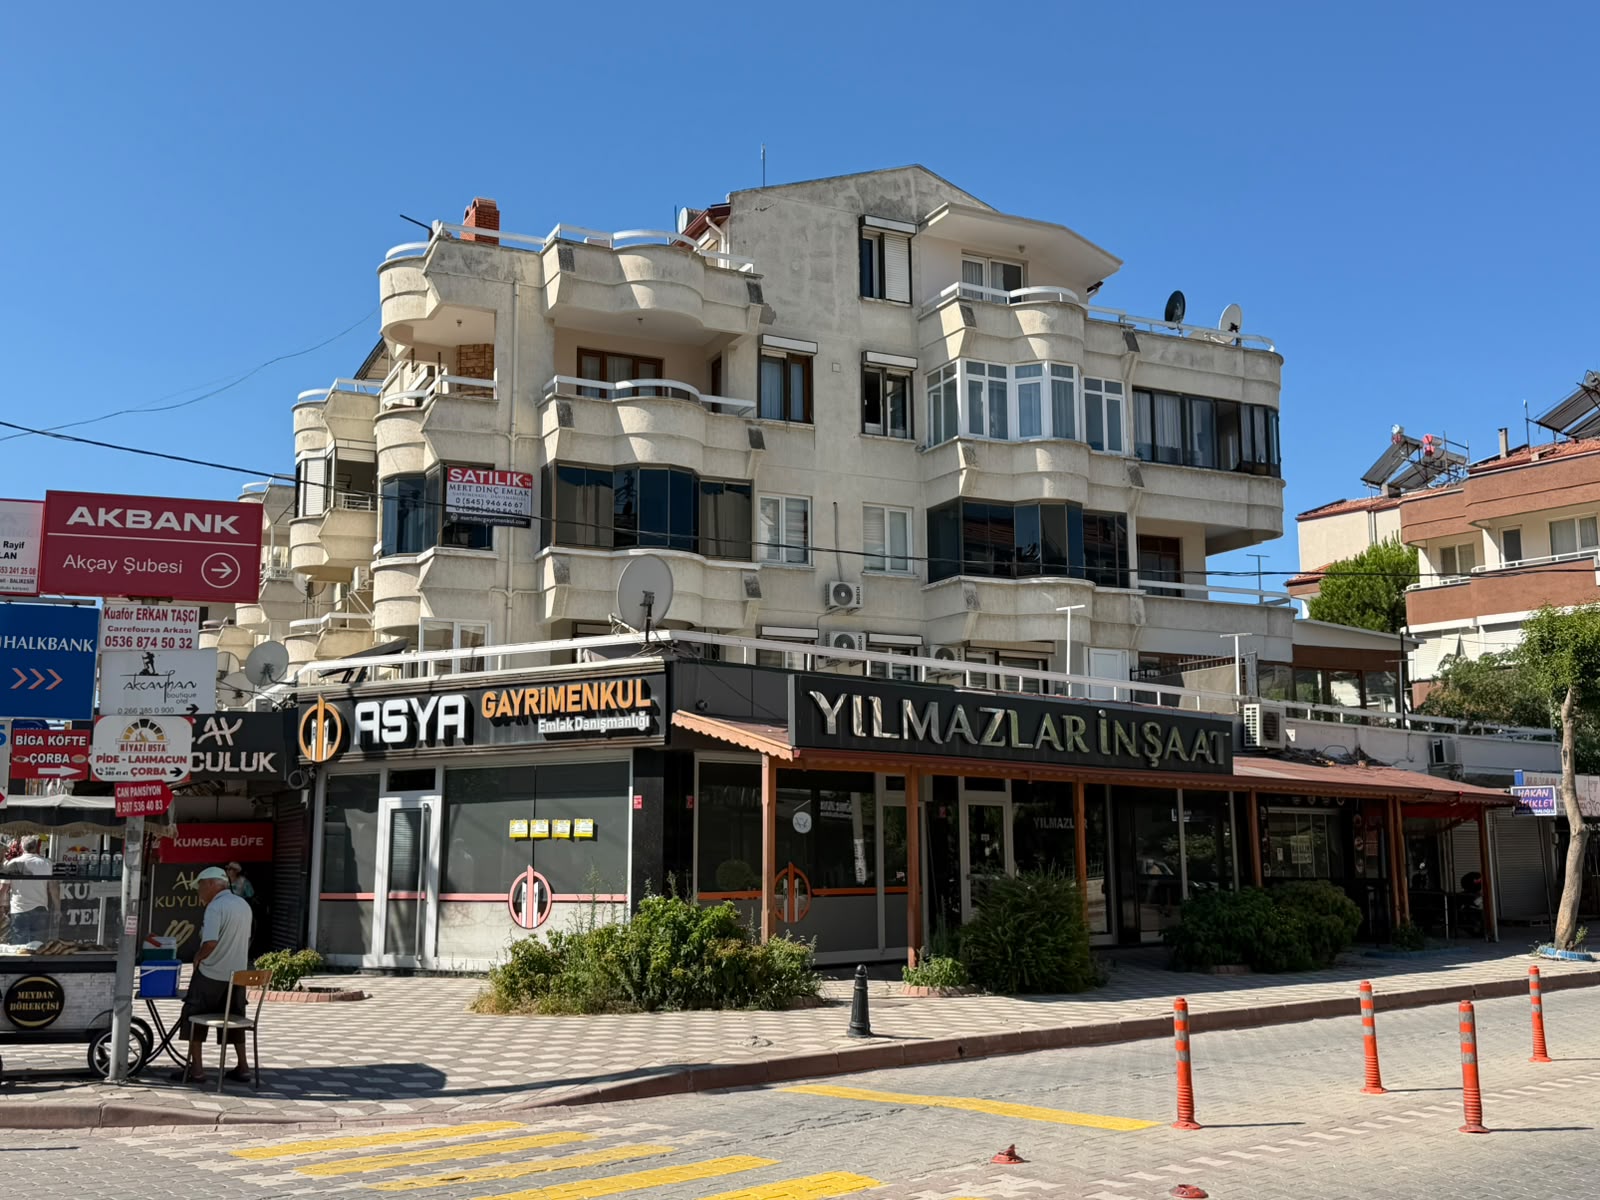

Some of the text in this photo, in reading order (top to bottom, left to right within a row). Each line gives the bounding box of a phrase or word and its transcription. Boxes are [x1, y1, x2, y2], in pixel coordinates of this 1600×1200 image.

[450, 469, 524, 487] SATILIK
[448, 484, 472, 493] MERT
[501, 488, 529, 497] EMLAK
[462, 498, 484, 506] (545)
[486, 499, 501, 507] 946
[514, 501, 523, 509] 67
[66, 506, 241, 535] AKBANK
[3, 540, 25, 551] Rayif
[9, 567, 19, 575] 241
[20, 567, 28, 575] 25
[63, 554, 183, 575] Akçay Şubesi
[104, 607, 198, 625] Kuaför ERKAN TAŞCI
[107, 625, 160, 633] Carrefoursa
[3, 635, 94, 653] HALKBANK
[105, 636, 193, 649] 0536 874 50 32
[354, 694, 466, 745] ASYA
[538, 711, 650, 734] Emlak Danışmanlığı
[809, 690, 1230, 767] YILMAZLAR İNŞAAT
[15, 733, 87, 746] BİGA KÖFTE
[148, 744, 166, 752] USTA
[29, 753, 70, 766] ÇORBA
[96, 753, 120, 763] PİDE
[128, 755, 187, 764] LAHMACUN
[130, 767, 167, 777] ÇORBA
[117, 784, 162, 797] CAN PANSİYON
[1517, 789, 1549, 798] HAKAN
[117, 800, 163, 813] 0 507 536 40 83
[1032, 816, 1088, 830] YILMAZLR
[173, 835, 264, 848] KUMSAL BÜFE
[63, 854, 78, 862] Red
[17, 991, 55, 999] MEYDAN
[9, 1000, 60, 1013] BÖREKÇİSİ
